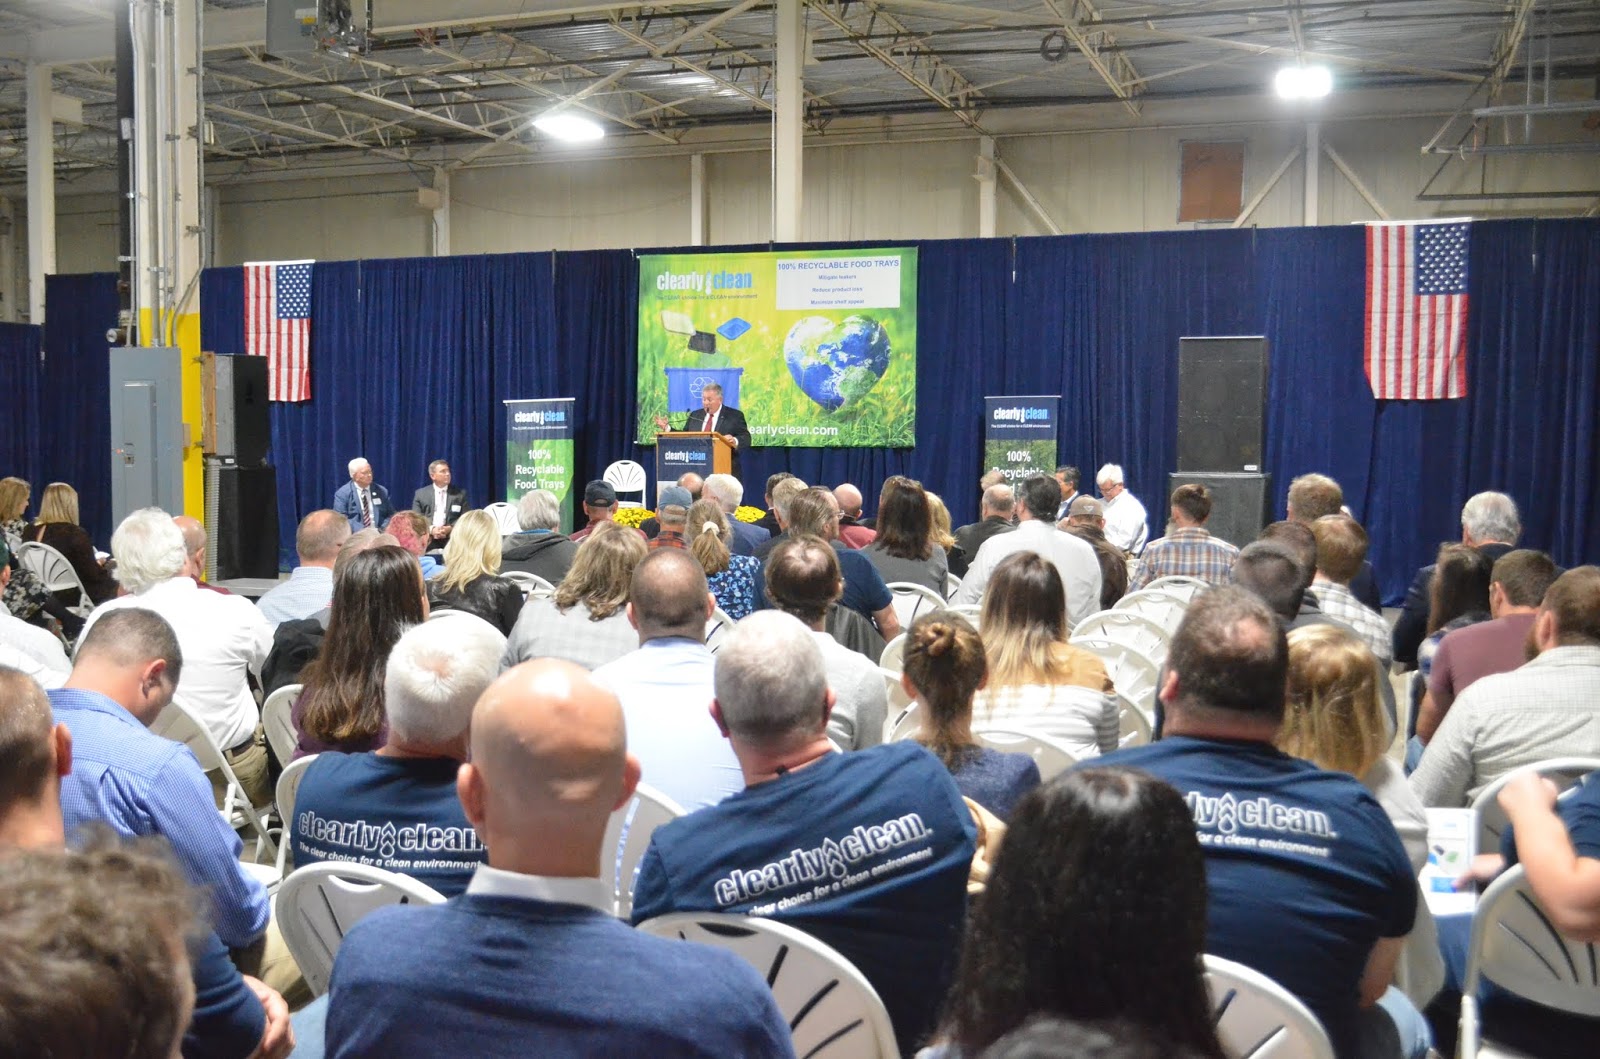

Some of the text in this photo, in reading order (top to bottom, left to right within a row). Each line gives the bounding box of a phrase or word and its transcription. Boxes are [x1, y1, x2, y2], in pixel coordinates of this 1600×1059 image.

[798, 261, 849, 270] RECYCLABLE
[850, 260, 872, 268] FOOD
[875, 259, 899, 268] TRAYS
[656, 270, 752, 292] clearly clean
[514, 410, 565, 423] clearly clean
[994, 407, 1048, 421] clearly clean
[749, 424, 838, 437] earlyclean.com
[528, 450, 551, 460] 100%
[665, 451, 706, 461] clearly clean
[1006, 450, 1031, 462] 100%
[515, 464, 565, 476] Recyclable
[514, 479, 565, 490] Food Trays
[299, 810, 381, 851] clearly
[1213, 834, 1224, 845] a
[1224, 833, 1257, 847] clean
[1258, 838, 1330, 858] environment
[299, 841, 311, 852] The
[310, 846, 328, 859] clear
[328, 850, 357, 863] choice
[359, 855, 374, 867] for
[375, 858, 383, 867] a
[384, 857, 411, 869] clean
[714, 847, 829, 907] clearly
[778, 891, 812, 910] choice
[813, 883, 831, 901] for
[832, 881, 841, 892] a
[841, 869, 870, 888] clean
[871, 847, 934, 876] environment
